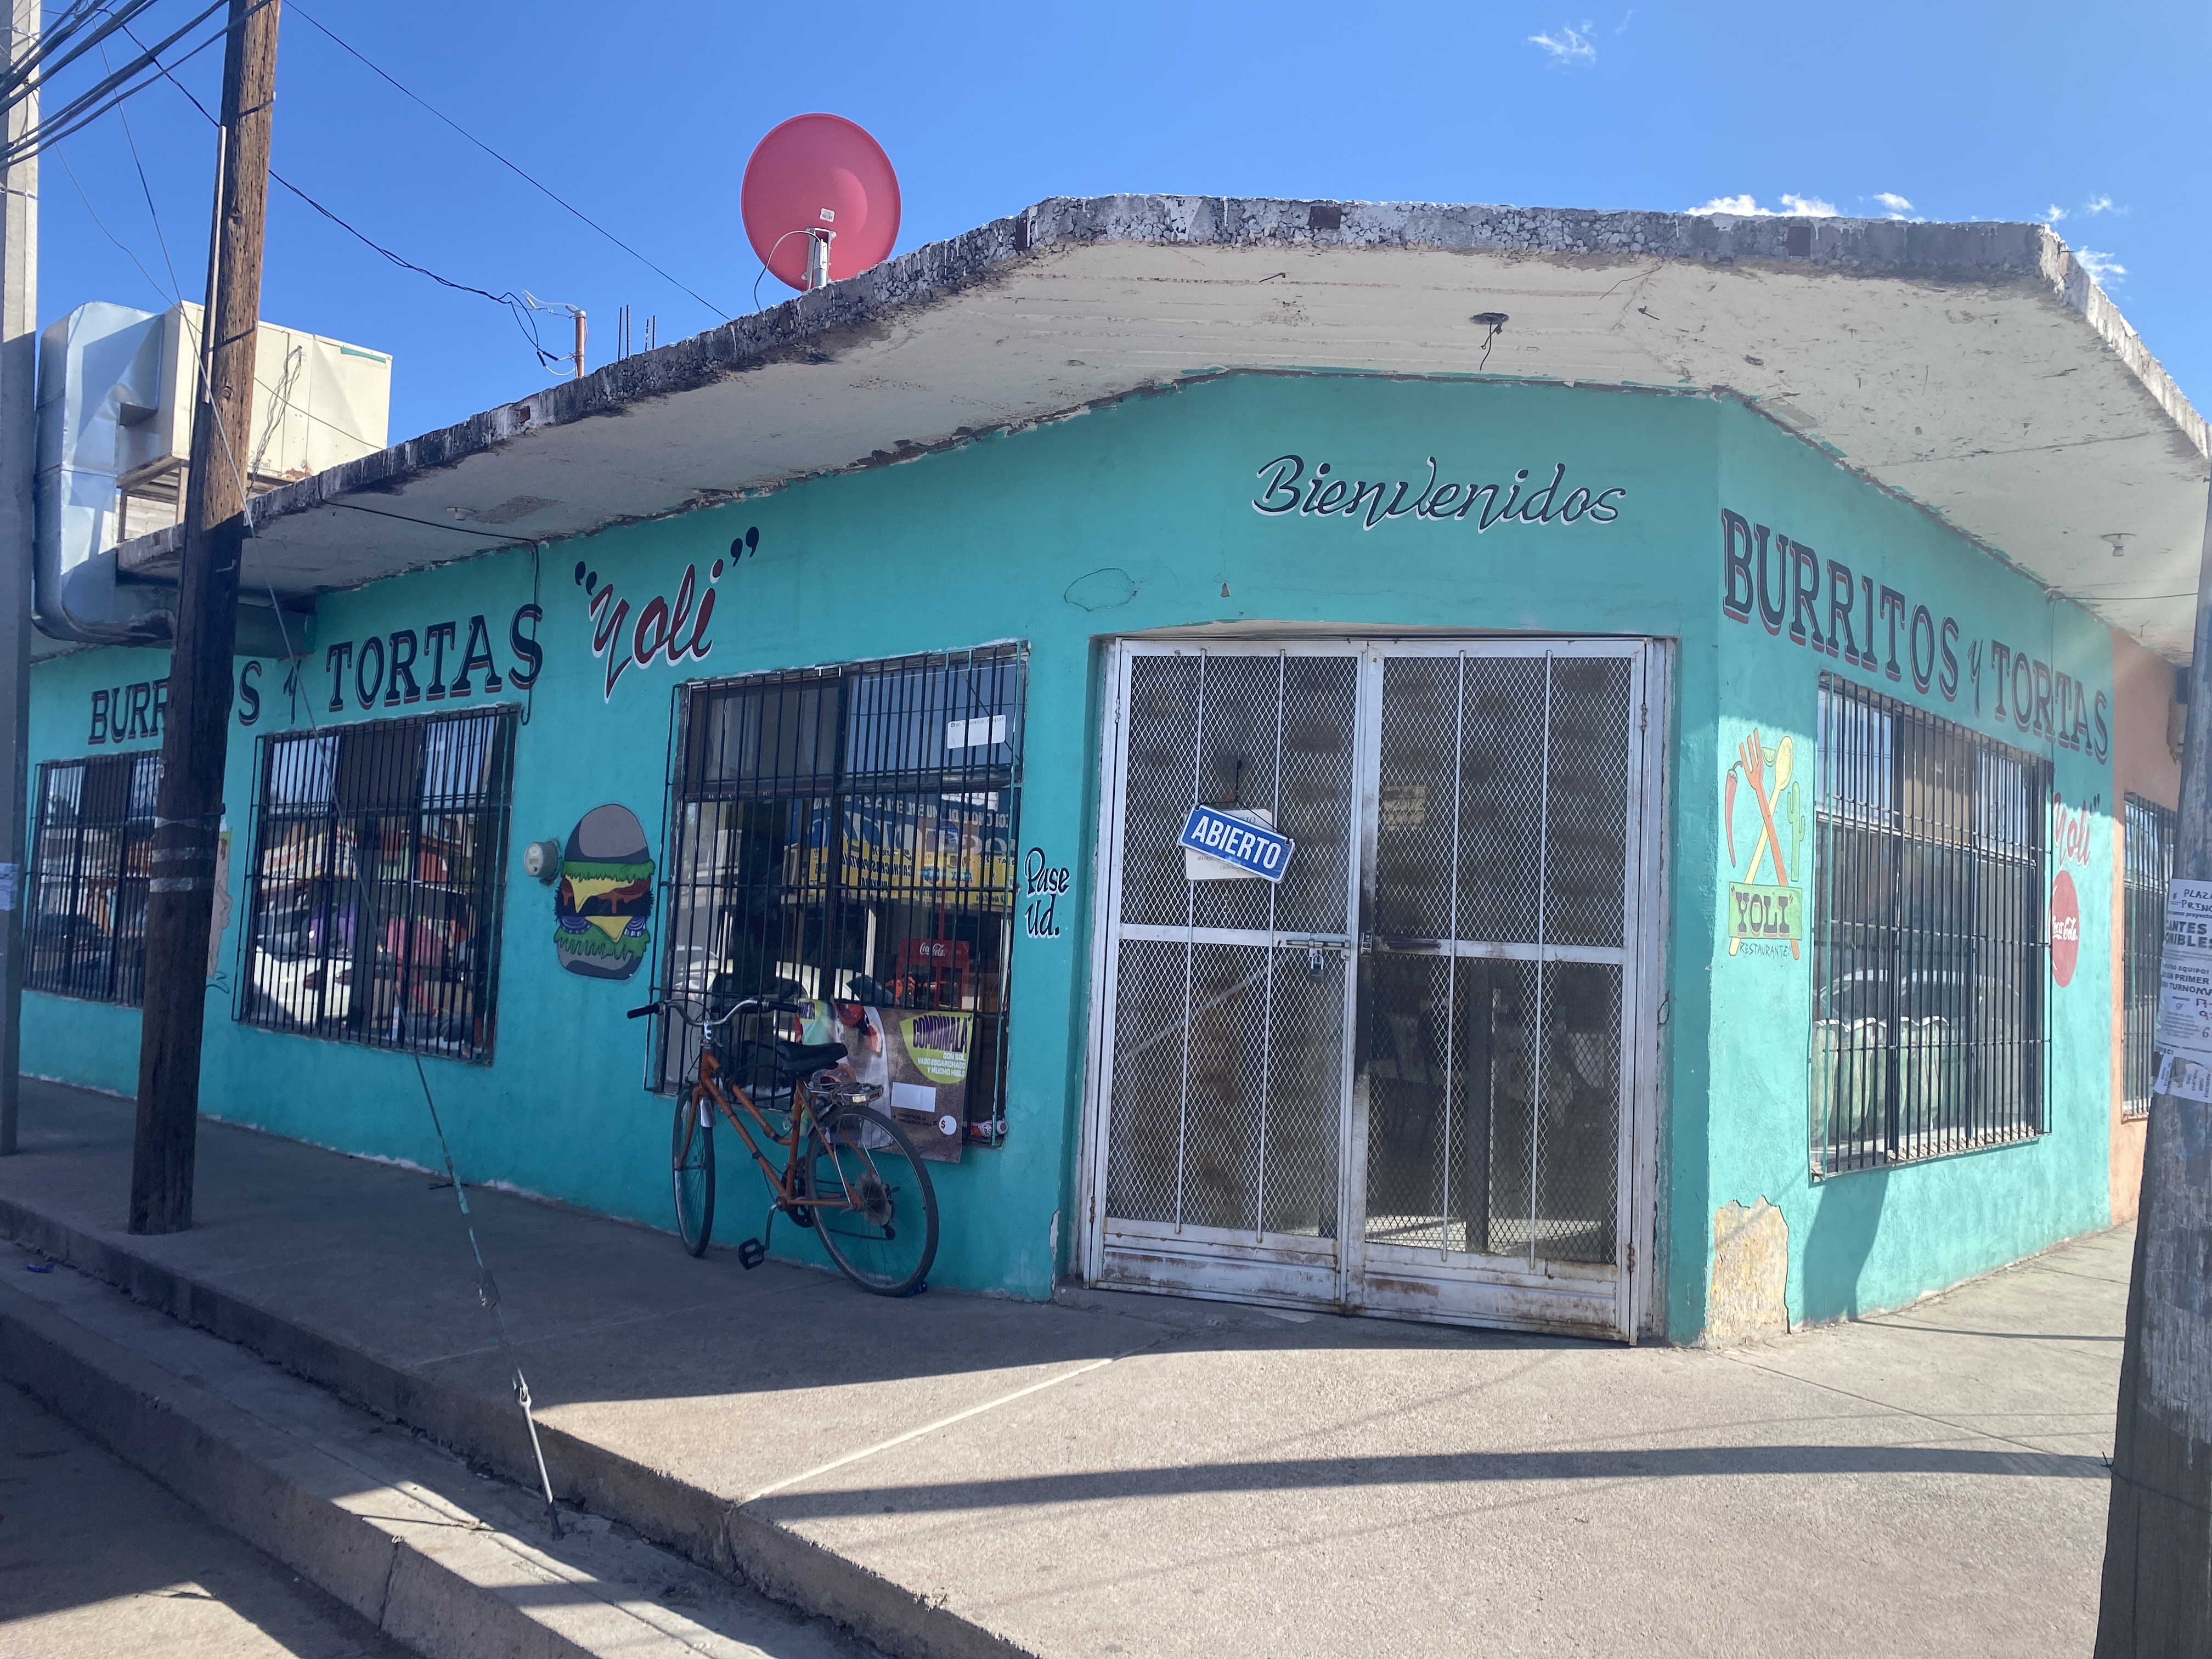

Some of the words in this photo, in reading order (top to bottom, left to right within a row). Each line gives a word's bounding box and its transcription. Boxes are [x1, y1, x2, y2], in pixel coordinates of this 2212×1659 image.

[1251, 454, 1627, 534] Bienvenidos
[1721, 507, 1959, 703] BURRITOS
[1991, 640, 2108, 765] TORTAS
[88, 660, 262, 745] BURRS
[326, 603, 543, 713] TORTAS
[1190, 815, 1282, 869] ABIERTO
[1024, 847, 1070, 898] Pase
[1024, 894, 1060, 939] Ud.
[2169, 983, 2196, 993] TURNO
[2175, 974, 2209, 985] PRIMER
[917, 1057, 930, 1065] VASO
[931, 1059, 966, 1069] ESCARCHADO
[931, 1066, 951, 1075] MUCHO
[951, 1069, 965, 1077] HIELO
[940, 1119, 946, 1130] $
